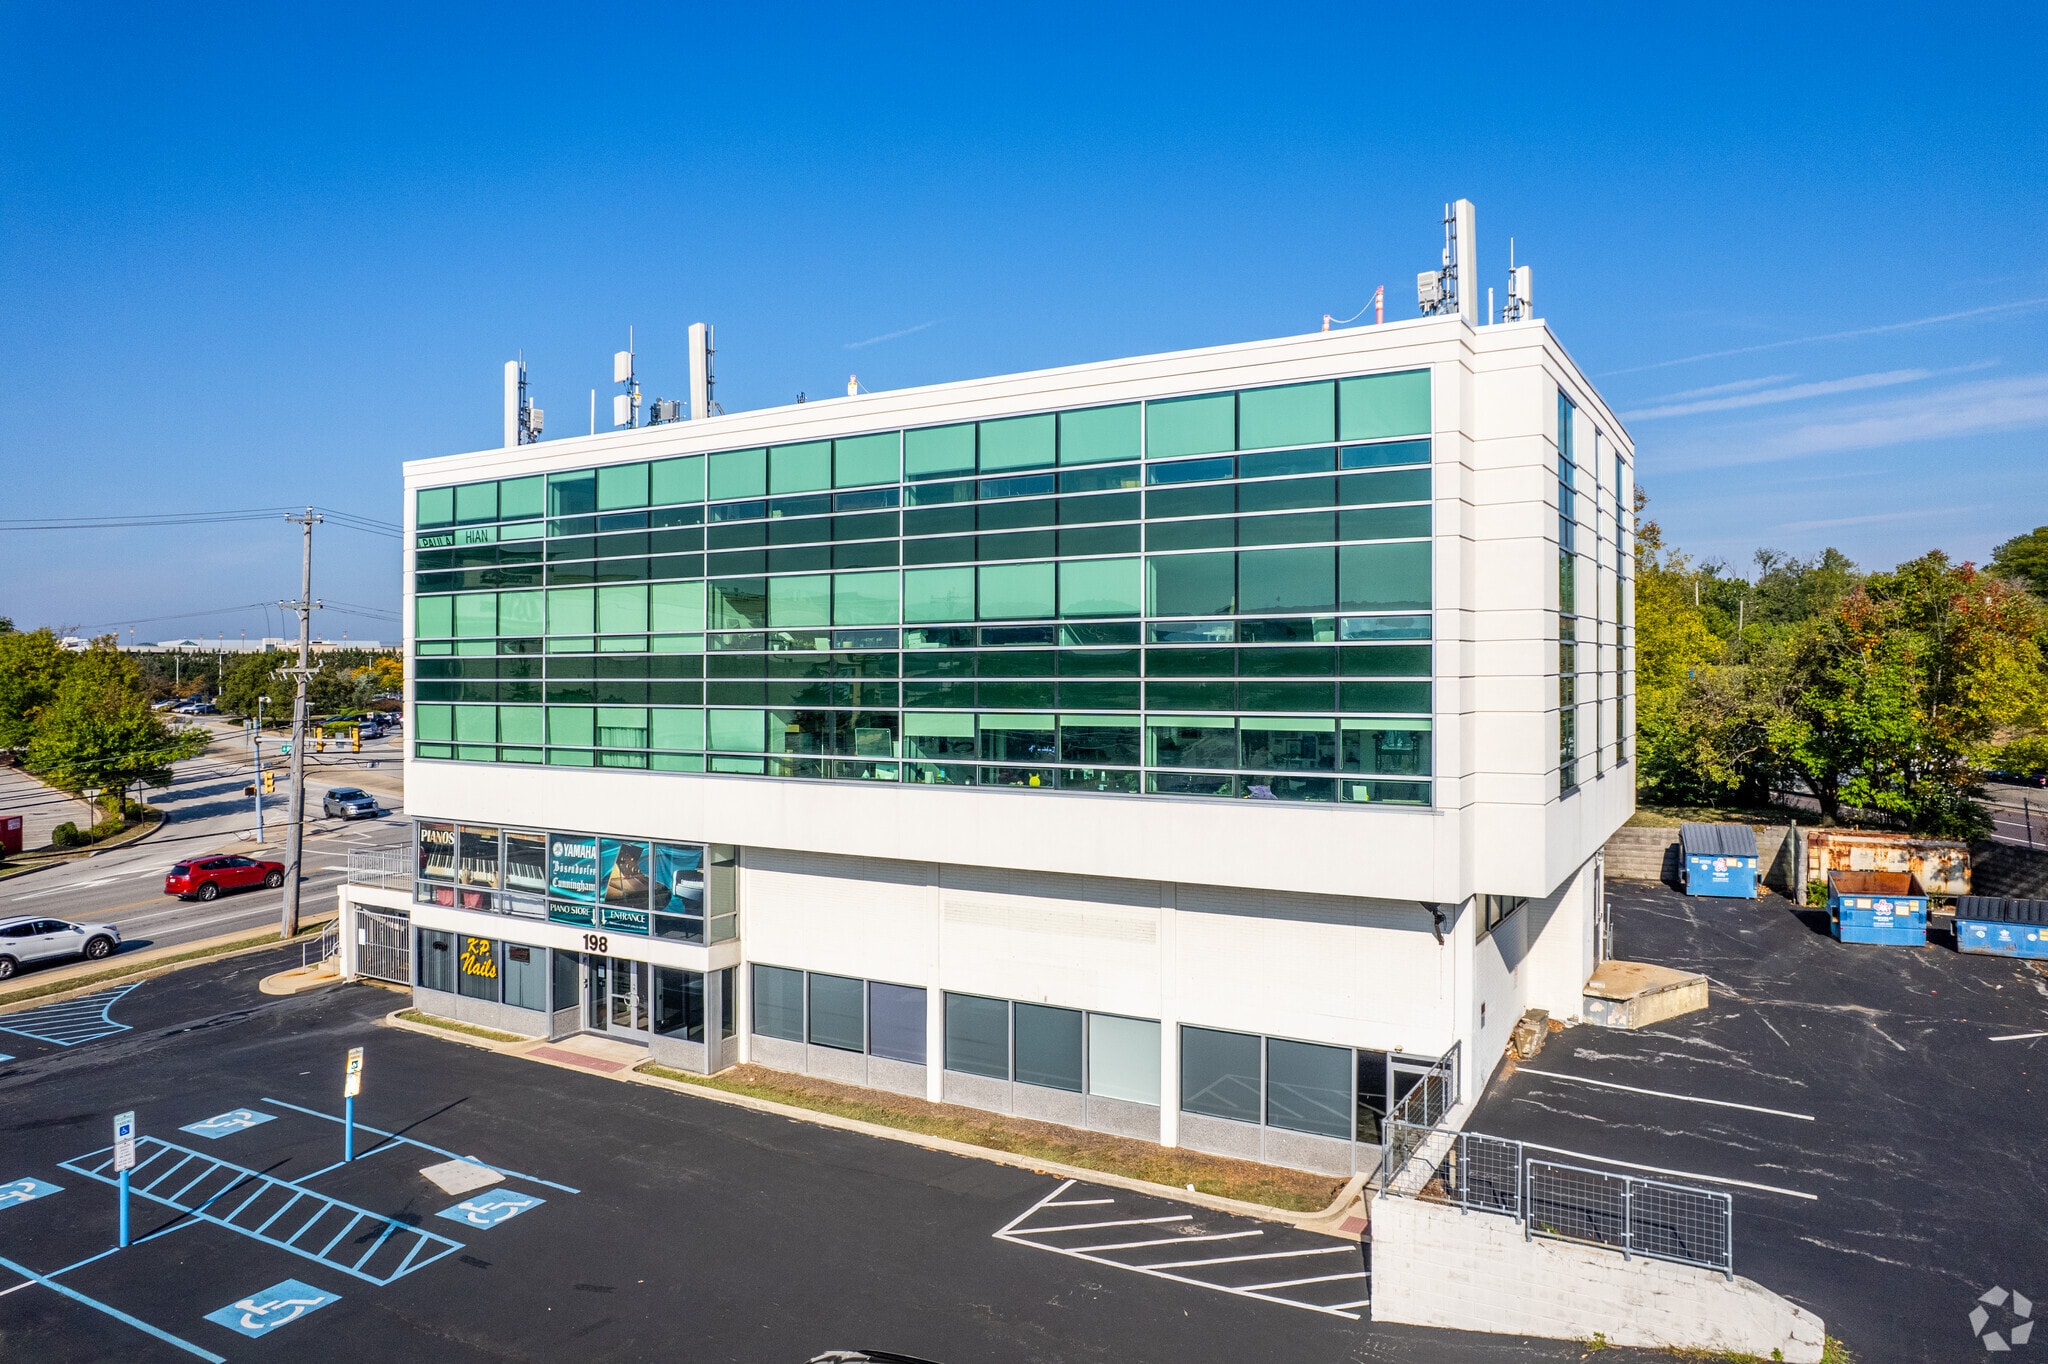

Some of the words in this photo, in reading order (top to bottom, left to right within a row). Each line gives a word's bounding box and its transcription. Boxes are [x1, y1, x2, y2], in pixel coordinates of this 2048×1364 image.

[465, 529, 488, 543] HIAN
[420, 829, 455, 844] PIANOS
[563, 843, 596, 859] YAMAHA
[550, 903, 570, 913] PIANO
[571, 905, 590, 916] STORE
[610, 911, 646, 923] ENTRANCE
[583, 933, 608, 953] 198
[460, 952, 497, 978] Nails
